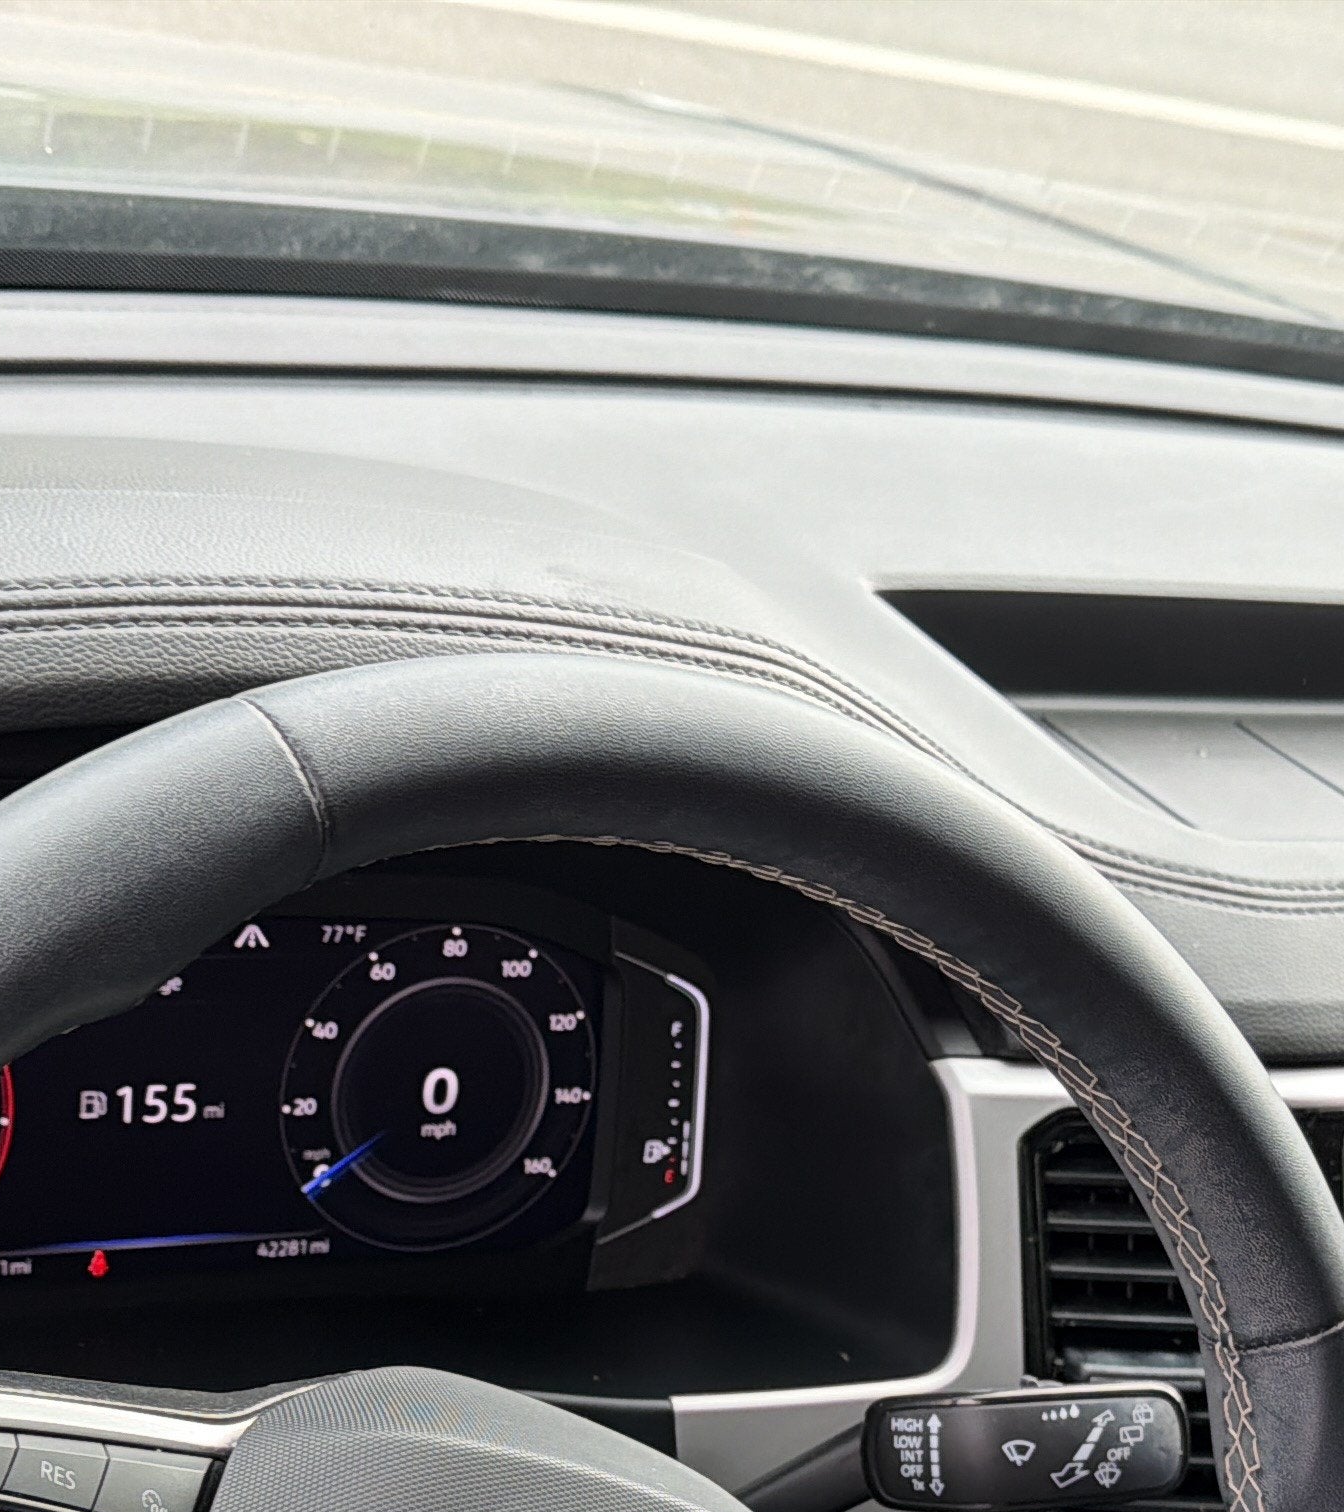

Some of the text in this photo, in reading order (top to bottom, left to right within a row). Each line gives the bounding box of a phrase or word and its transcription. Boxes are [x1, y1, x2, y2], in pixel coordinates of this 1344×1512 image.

[320, 924, 367, 943] 77°F
[442, 939, 468, 957] 80
[369, 962, 396, 981] 60
[501, 960, 532, 978] 100
[311, 1021, 339, 1040] 40
[549, 1013, 577, 1031] 120
[422, 1067, 459, 1115] 0
[555, 1087, 583, 1104] 140
[116, 1083, 225, 1124] 155 mi
[292, 1097, 318, 1116] 20
[420, 1121, 457, 1141] mph
[524, 1156, 552, 1175] 160
[890, 1417, 924, 1432] HIGH
[893, 1434, 923, 1449] LOW
[900, 1449, 924, 1463] INT
[1107, 1446, 1132, 1462] OFF
[39, 1459, 77, 1490] RES
[900, 1464, 924, 1478] OFF
